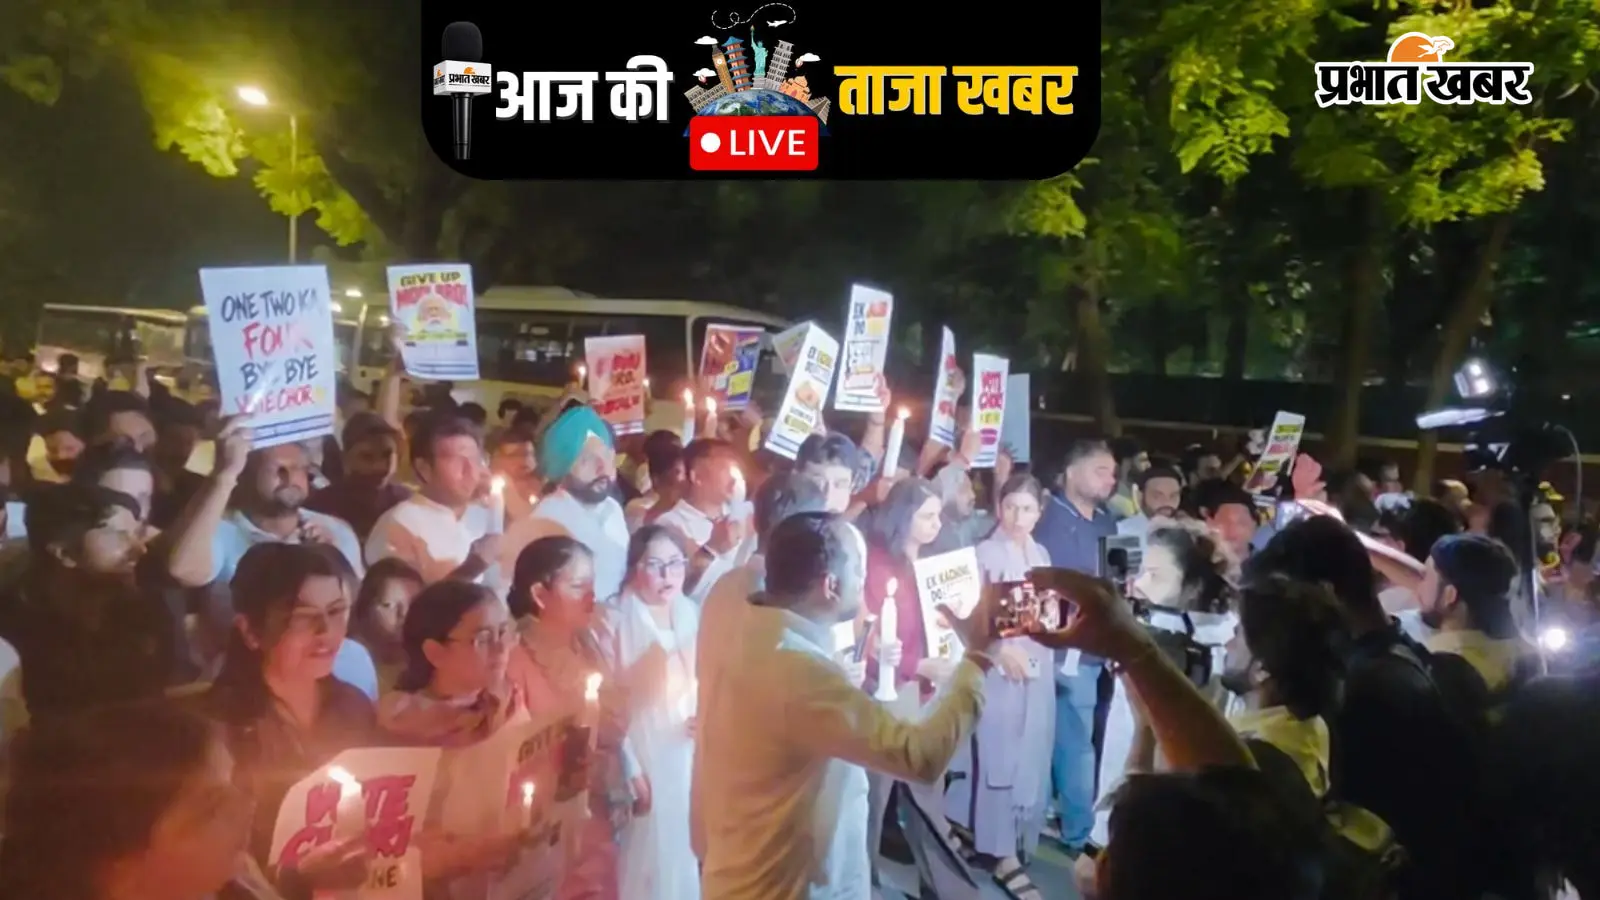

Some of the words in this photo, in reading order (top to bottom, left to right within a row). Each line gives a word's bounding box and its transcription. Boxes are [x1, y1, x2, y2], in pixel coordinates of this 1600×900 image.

[400, 273, 436, 288] GIVE
[440, 271, 461, 283] UP
[220, 292, 260, 323] ONE
[259, 290, 295, 318] TWO
[240, 360, 281, 391] BY
[284, 354, 319, 385] BYE
[233, 396, 275, 417] VTE
[305, 775, 416, 830] VTE
[277, 814, 414, 873] CHRI
